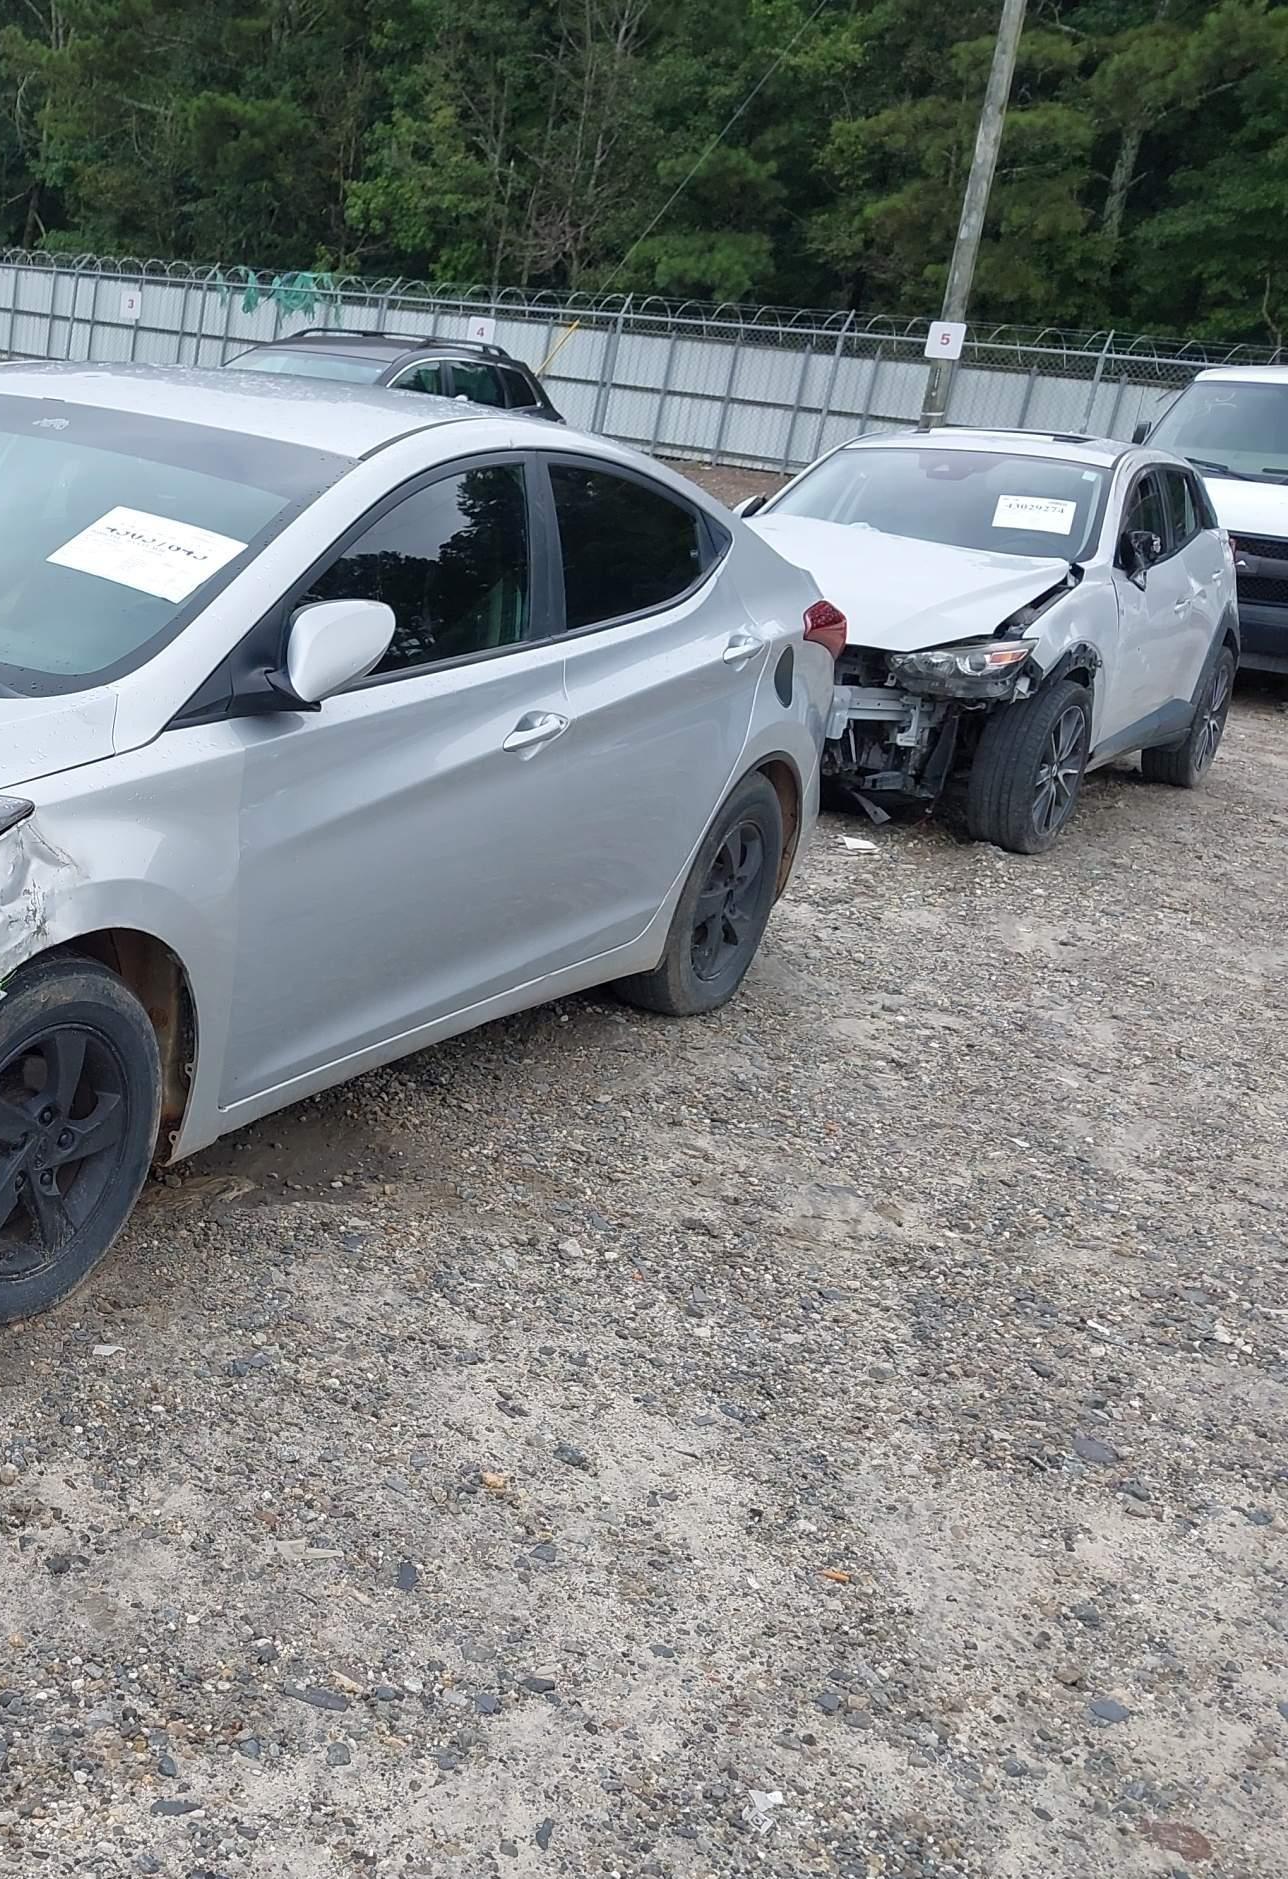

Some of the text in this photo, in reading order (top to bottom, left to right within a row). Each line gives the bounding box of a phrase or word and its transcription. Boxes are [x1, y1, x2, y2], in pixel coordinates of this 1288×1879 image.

[128, 299, 135, 309] 3
[476, 327, 485, 337] 4
[940, 333, 951, 346] 5
